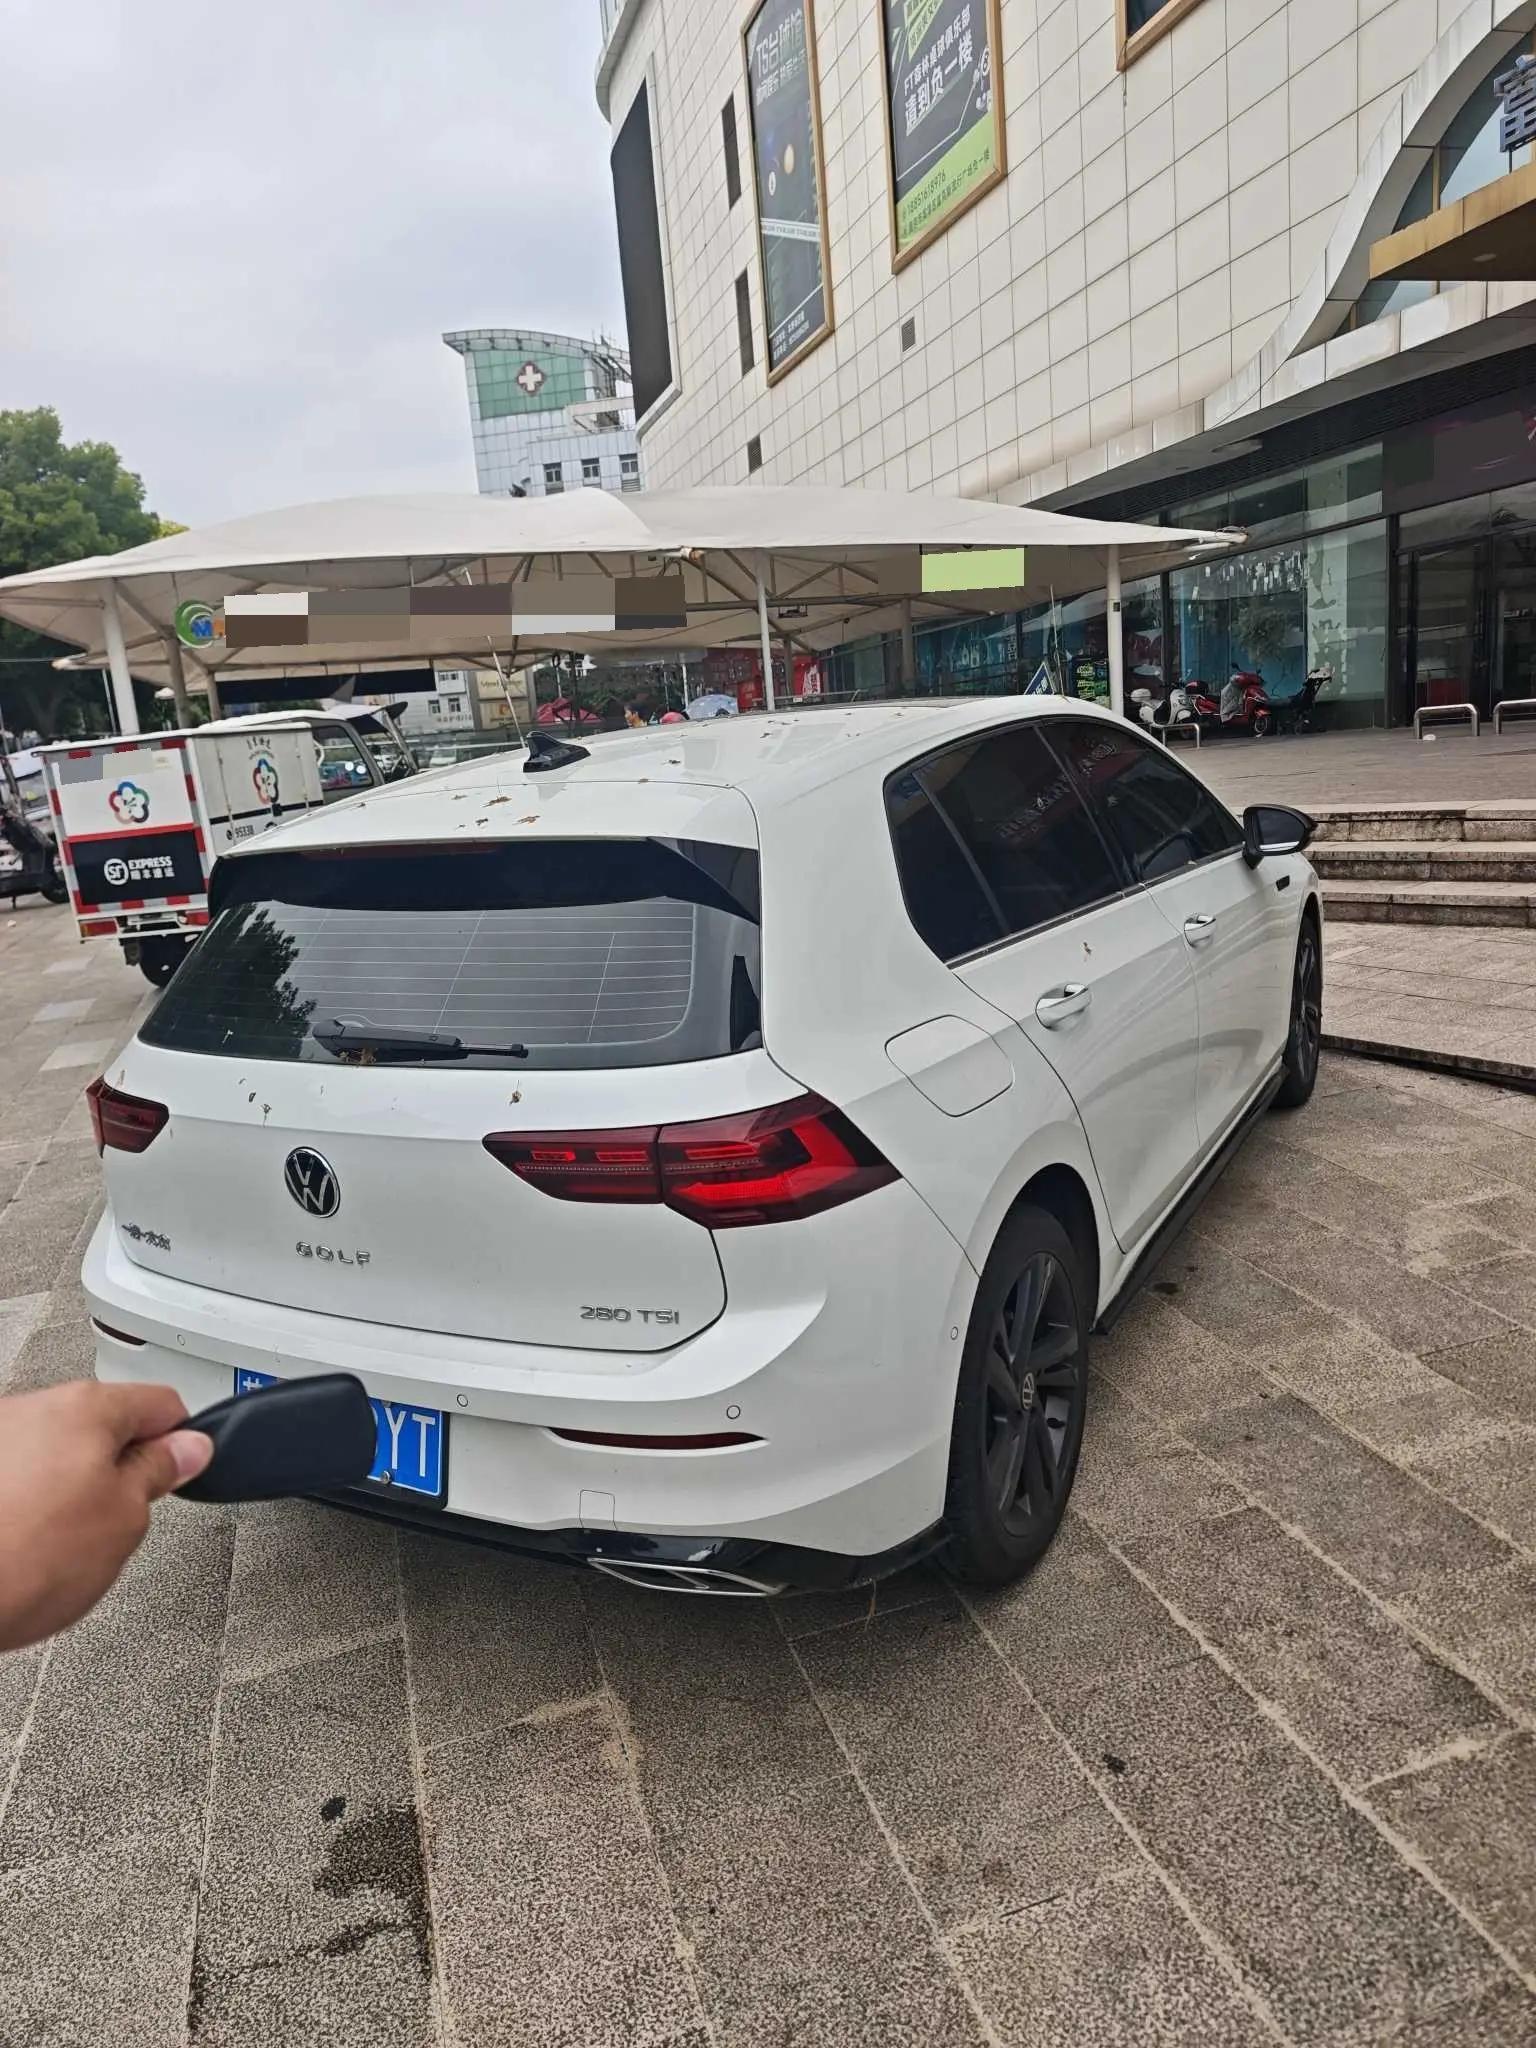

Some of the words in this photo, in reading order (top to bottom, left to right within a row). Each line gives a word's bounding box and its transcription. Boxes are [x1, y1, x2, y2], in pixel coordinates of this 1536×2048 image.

[905, 28, 973, 132] 请到负一楼
[128, 855, 173, 870] EXPRESS
[296, 1241, 370, 1266] GOLF
[580, 1305, 632, 1322] 280
[636, 1308, 680, 1325] TSI
